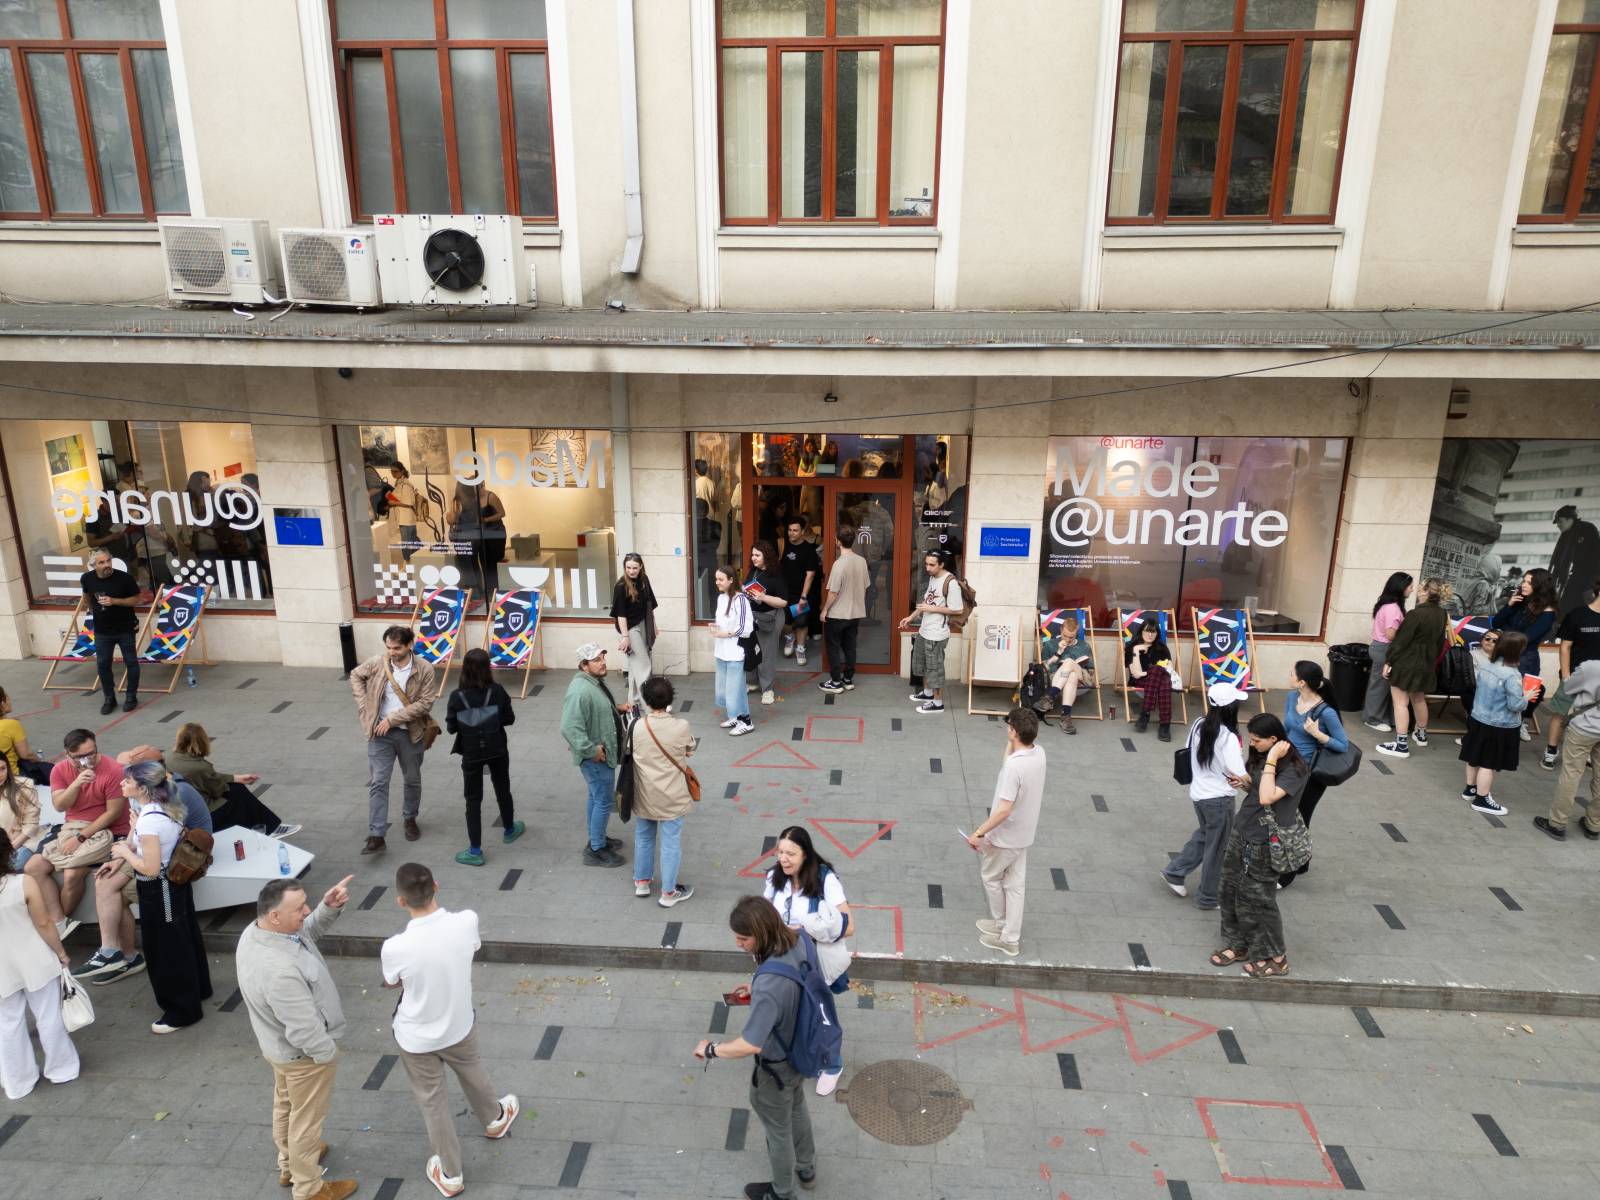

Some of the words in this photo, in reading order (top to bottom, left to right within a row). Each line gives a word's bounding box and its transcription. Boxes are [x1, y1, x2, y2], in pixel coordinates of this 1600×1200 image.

[1100, 436, 1164, 450] @unarte
[1053, 447, 1220, 498] Made
[1050, 497, 1289, 547] @unarte
